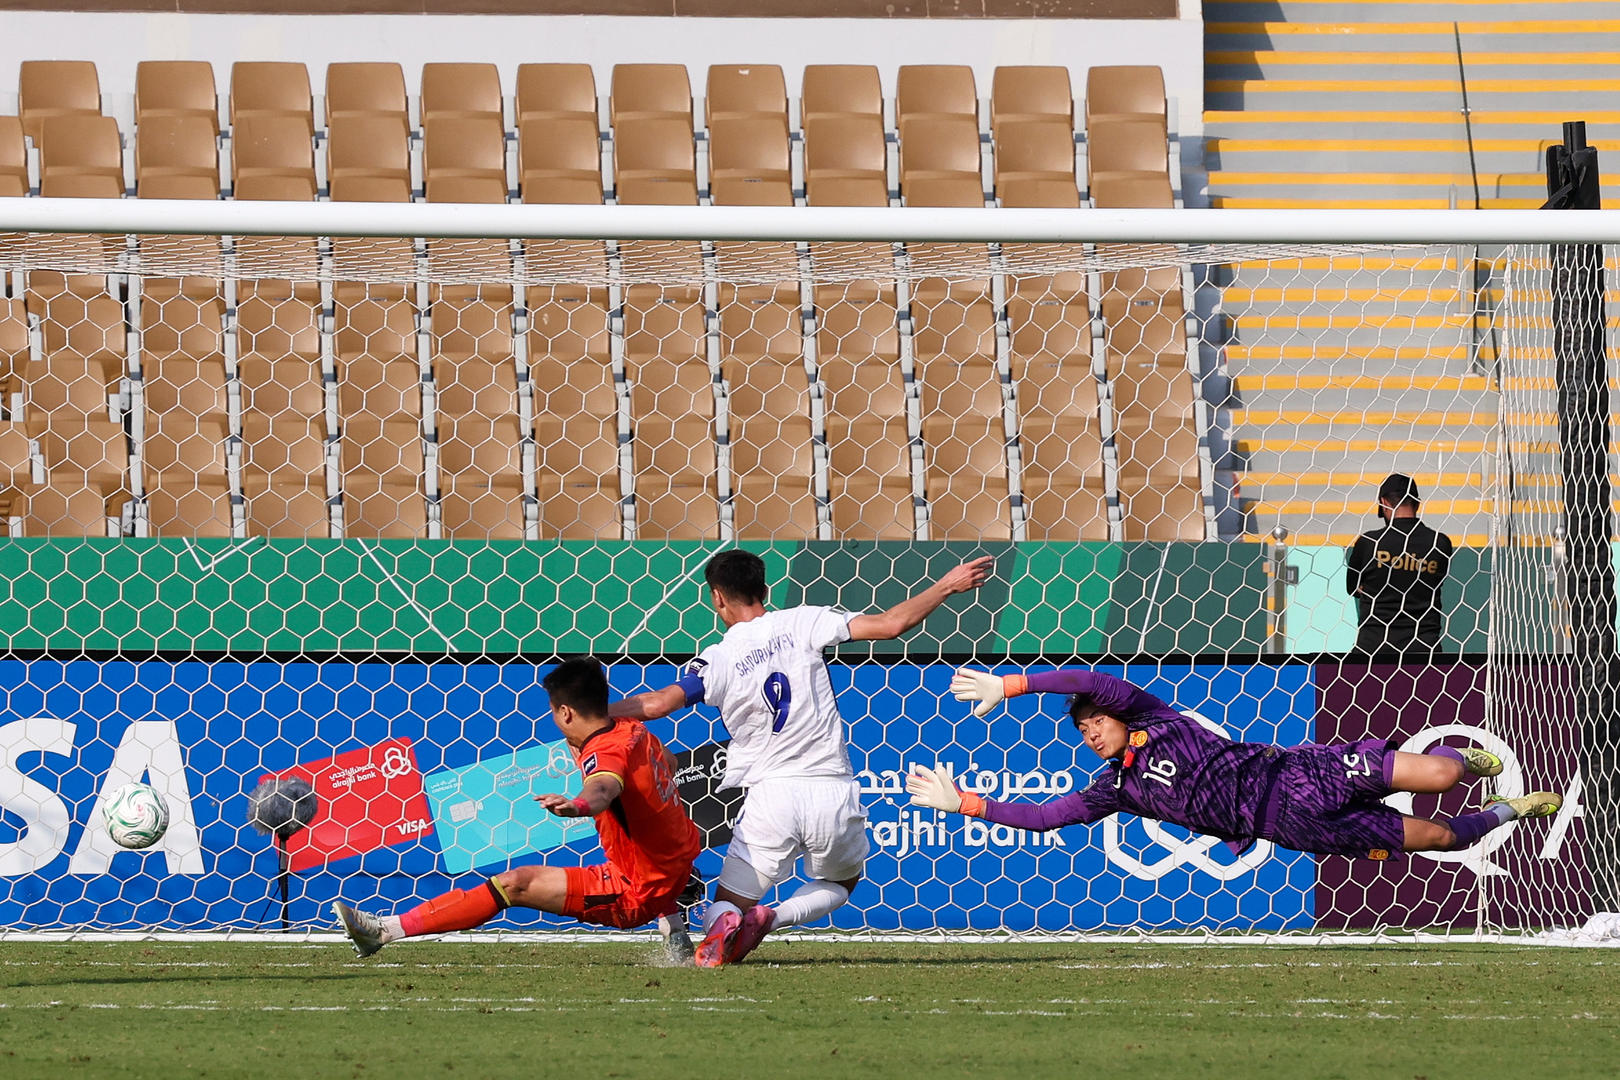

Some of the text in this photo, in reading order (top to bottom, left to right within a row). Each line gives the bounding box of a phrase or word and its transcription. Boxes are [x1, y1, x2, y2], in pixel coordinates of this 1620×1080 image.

[1376, 551, 1438, 574] Police
[761, 671, 791, 736] 9
[357, 771, 377, 782] bank
[959, 763, 1074, 803] مصرف
[1142, 757, 1177, 787] 16
[395, 819, 428, 835] VISA
